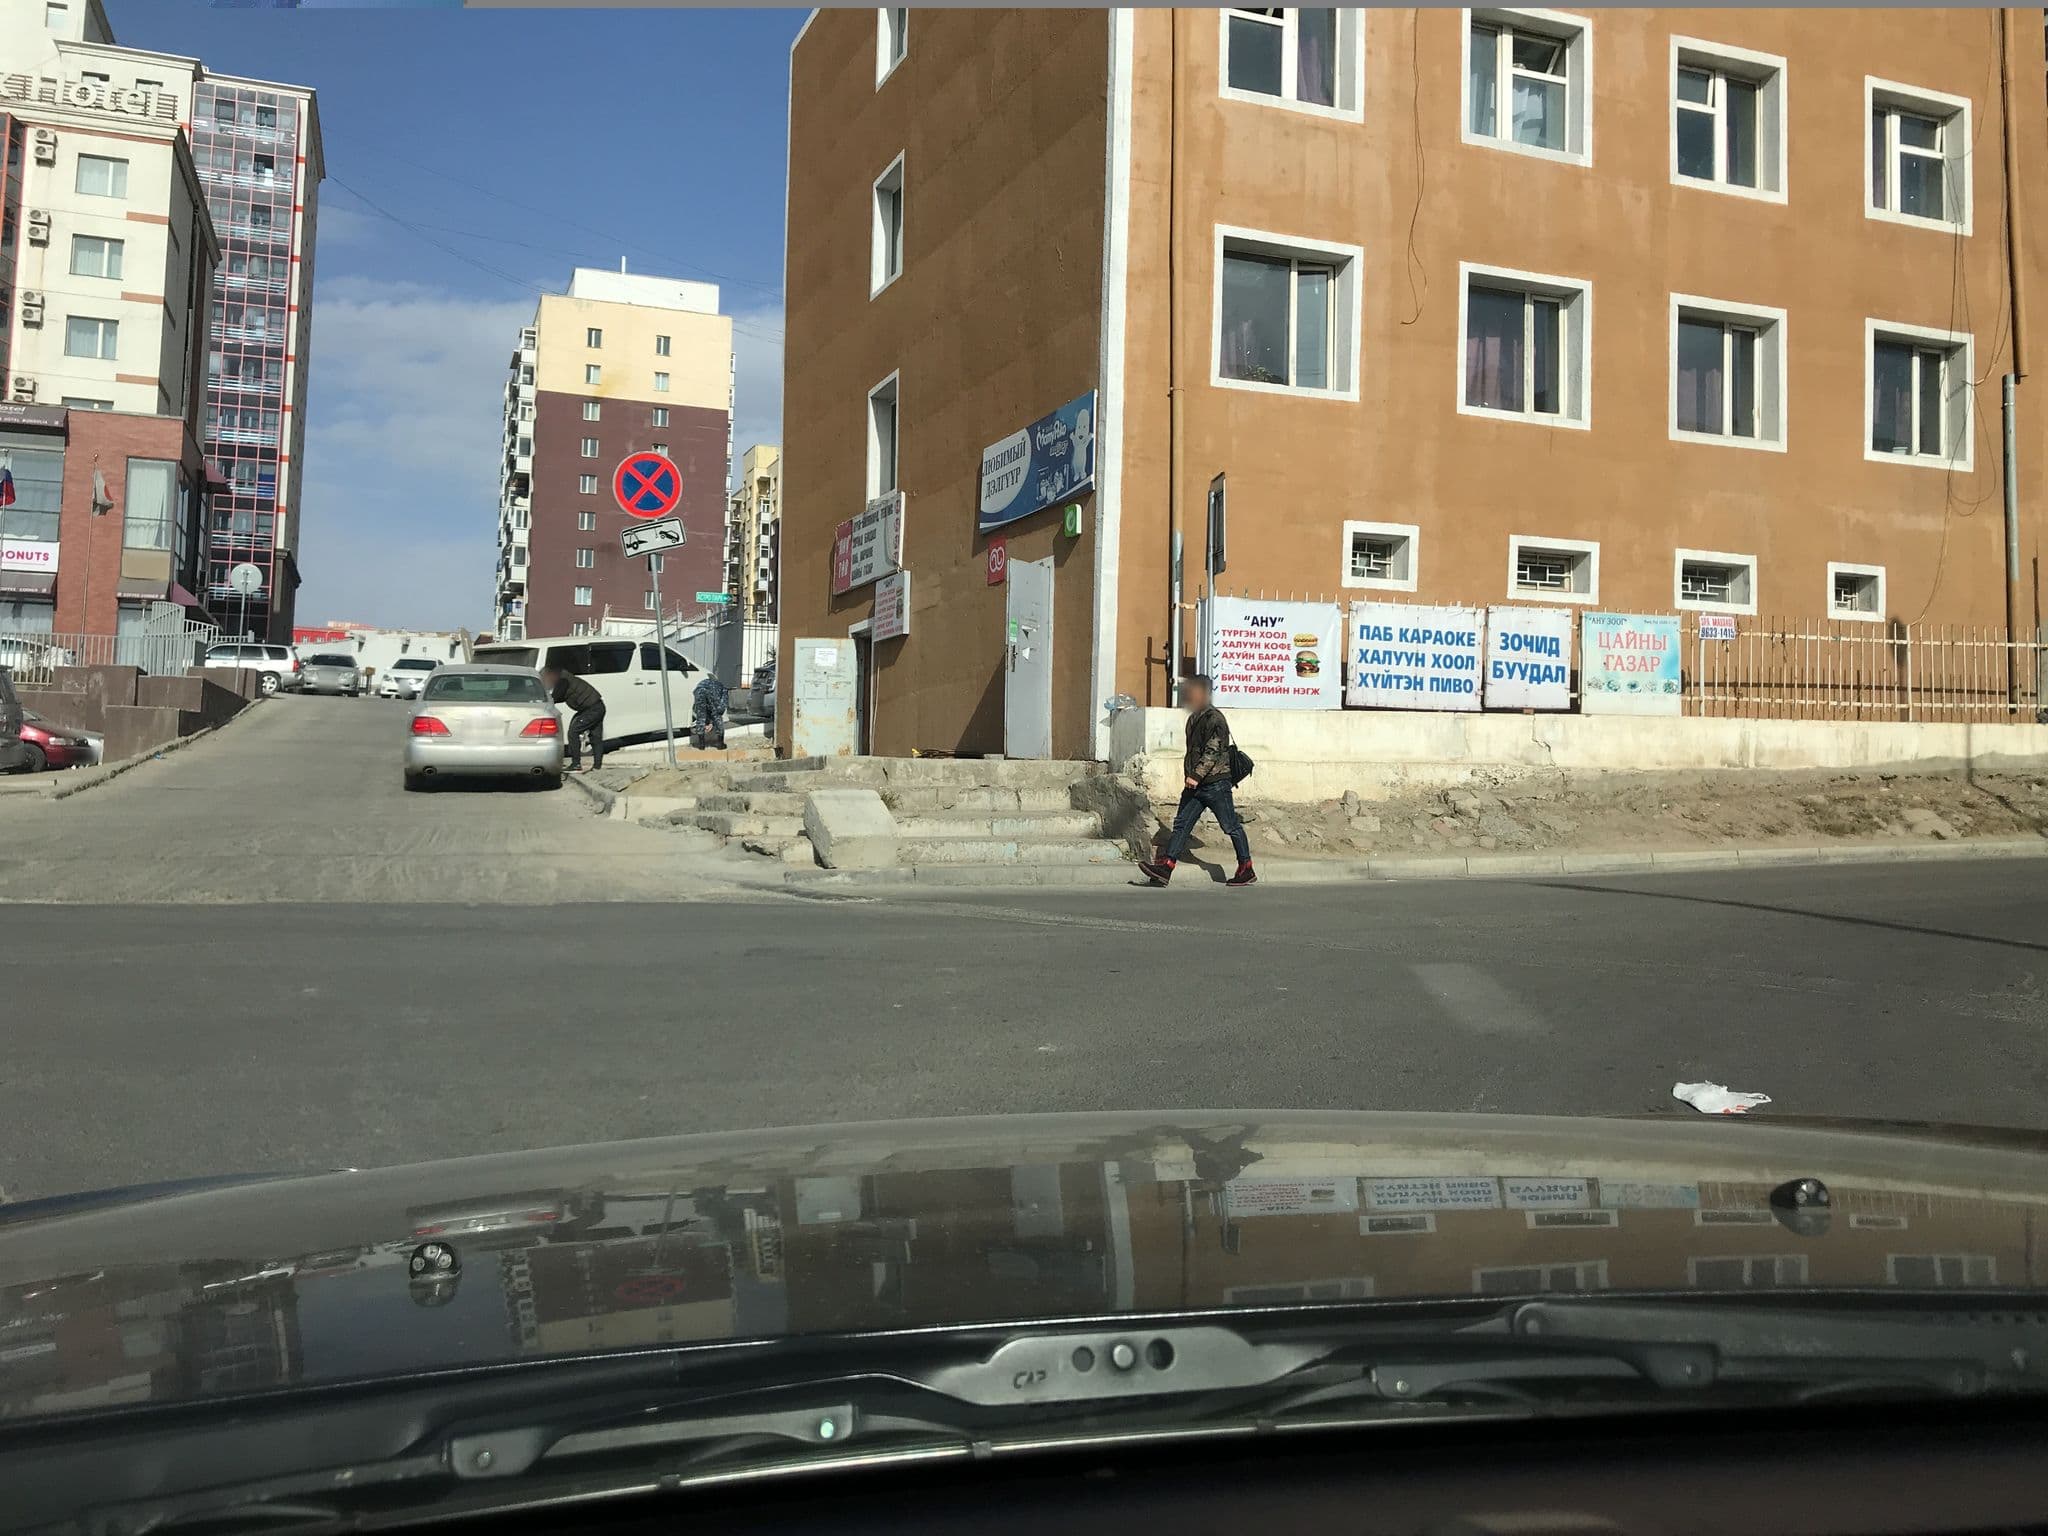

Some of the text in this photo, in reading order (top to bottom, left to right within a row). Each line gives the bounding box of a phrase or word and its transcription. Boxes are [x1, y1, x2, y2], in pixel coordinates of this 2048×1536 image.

[31, 72, 160, 118] Hotel
[983, 437, 1026, 477] ЛЮБИМЫЙ
[985, 467, 1021, 500] ДЭЛГҮҮР
[1244, 616, 1284, 627] "АНУ"
[1222, 629, 1287, 639] ТҮРГЭН ХООЛ
[1359, 624, 1476, 647] ПАБ КАРАОКЕ
[1598, 630, 1667, 651] ЦАЙНЫ
[1222, 640, 1291, 650] ХАЛУУН КОФЕ
[1500, 632, 1560, 658] ЗОЧИД
[1221, 651, 1291, 661] АХУЙН БАРАА
[1358, 648, 1475, 671] ХАЛУУН ХООЛ
[1605, 654, 1661, 673] ГАЗАР
[1244, 662, 1284, 672] САЙХАН
[1492, 660, 1566, 685] БУУДАЛ
[1221, 673, 1285, 683] БИЧИГ ХЭРЭГ
[1358, 669, 1474, 694] ХҮЙТЭН ПИВО
[1221, 685, 1320, 695] БҮХ ТӨРЛИЙН НЭГЖ
